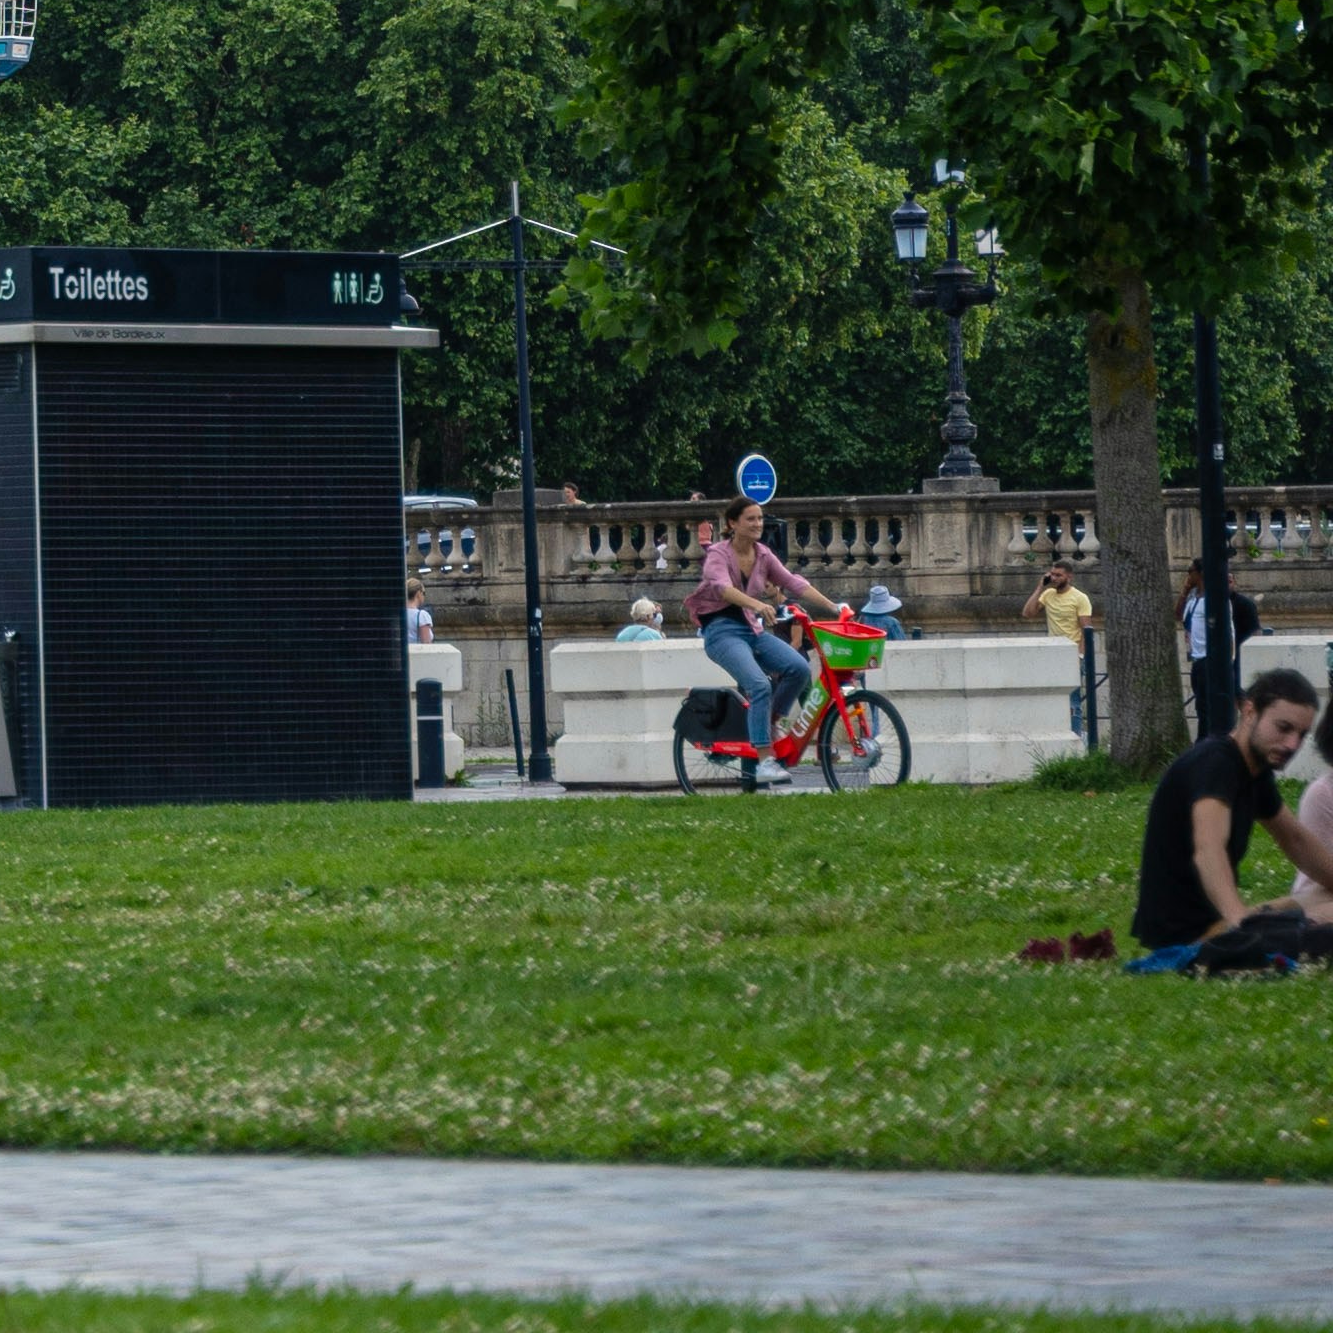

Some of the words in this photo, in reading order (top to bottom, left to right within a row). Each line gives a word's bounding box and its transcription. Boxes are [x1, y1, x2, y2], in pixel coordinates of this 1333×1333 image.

[49, 267, 148, 300] Toilettes
[73, 329, 94, 338] Ville
[96, 329, 110, 338] de
[112, 328, 165, 339] Bordeaux
